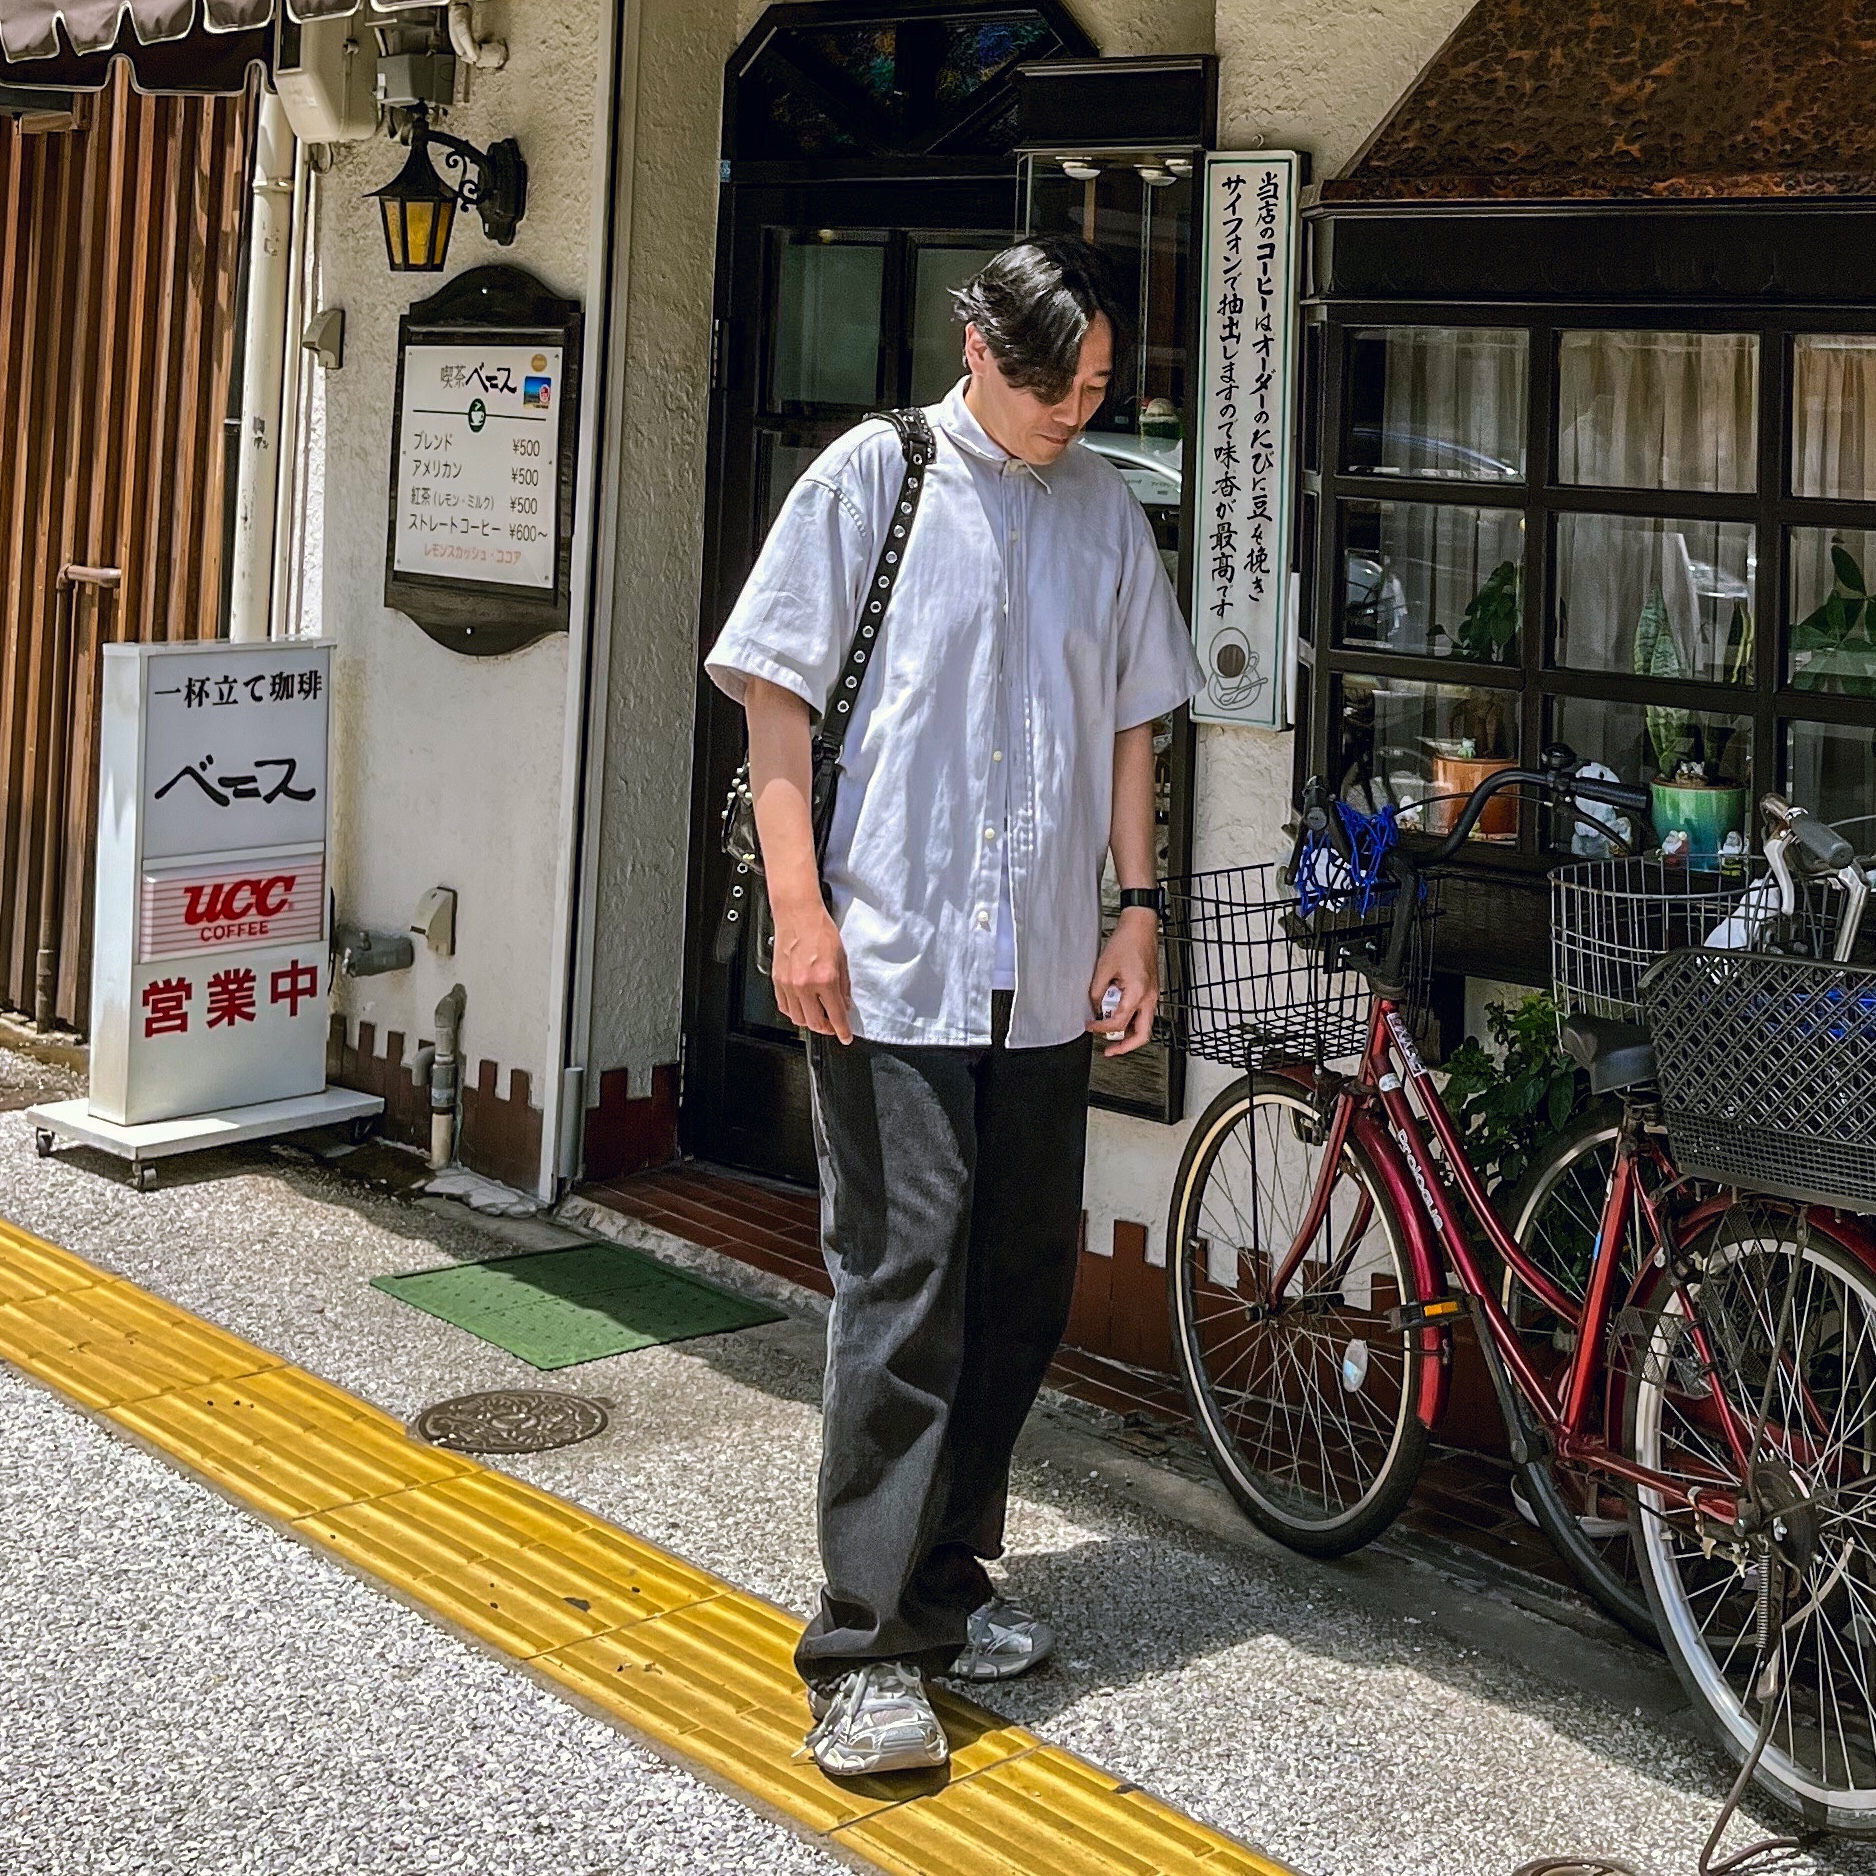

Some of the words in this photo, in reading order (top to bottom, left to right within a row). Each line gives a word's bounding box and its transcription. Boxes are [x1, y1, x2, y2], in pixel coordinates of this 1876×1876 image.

[1244, 171, 1279, 601] 当店のコーヒーはオーダーのたびに豆を挽き
[413, 432, 453, 451] ブレンド
[512, 438, 541, 457] ¥500
[411, 459, 463, 479] アメリカン
[511, 467, 539, 487] ¥500
[509, 496, 538, 516] ¥500
[409, 513, 501, 537] ストレートコーヒー
[154, 670, 323, 709] 一杯立て珈琲
[154, 754, 317, 807] ベース
[200, 921, 270, 943] COFFEE
[142, 958, 318, 1039] 営業中
